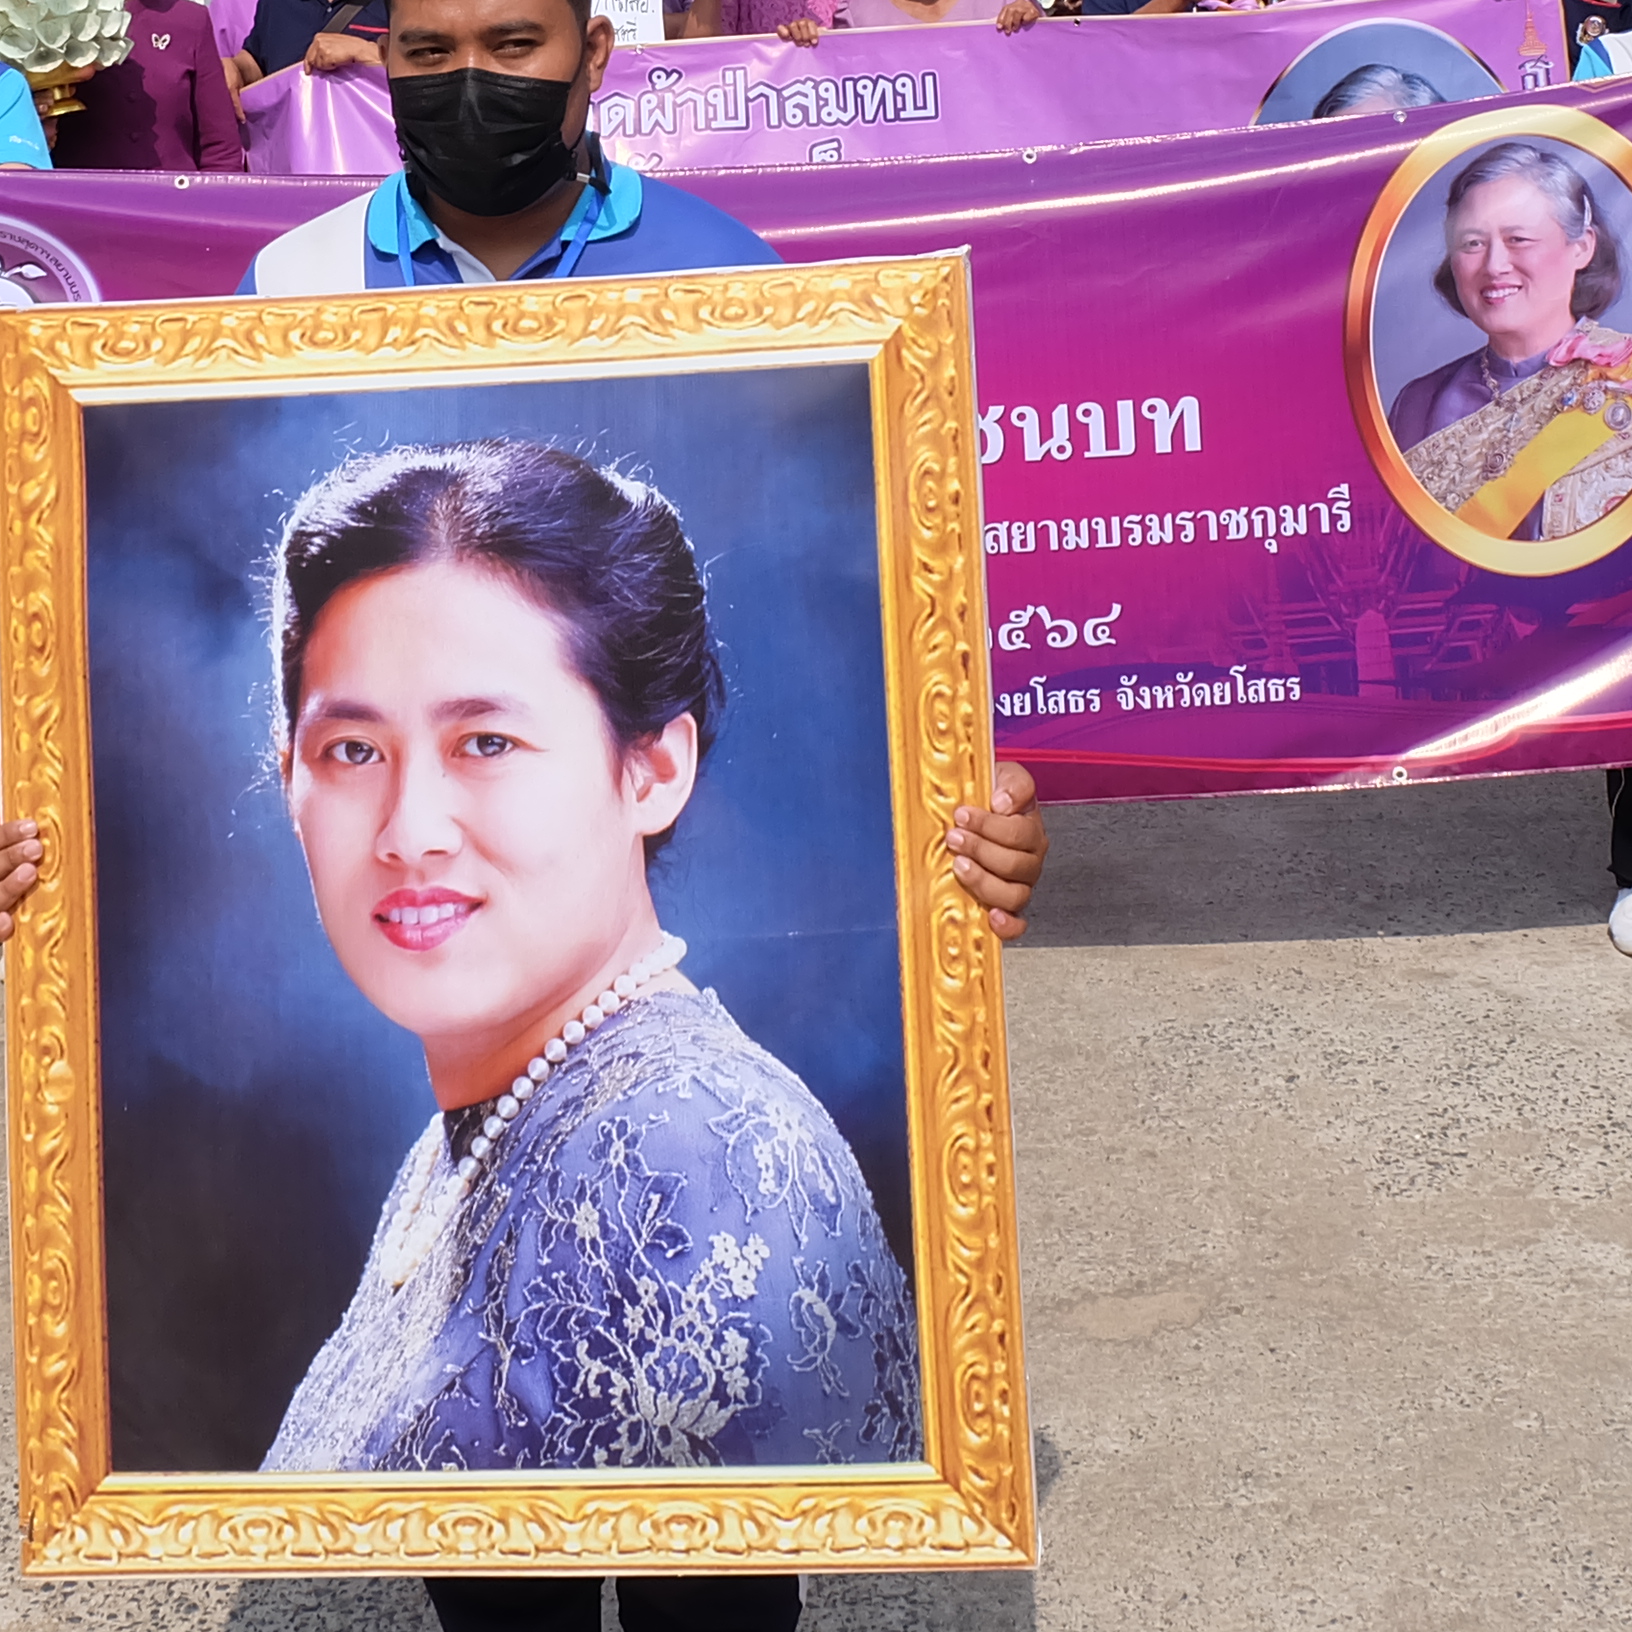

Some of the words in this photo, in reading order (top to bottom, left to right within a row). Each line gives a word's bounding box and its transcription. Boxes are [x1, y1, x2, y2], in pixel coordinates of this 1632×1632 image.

[589, 66, 940, 138] ดผ้าป่าสมทบ
[984, 482, 1352, 555] สยามบรมราชกุมารี
[988, 602, 1123, 652] ๕๖๔
[994, 675, 1101, 717] งยโสธร
[1116, 665, 1302, 712] จังหวัดยโสธร
